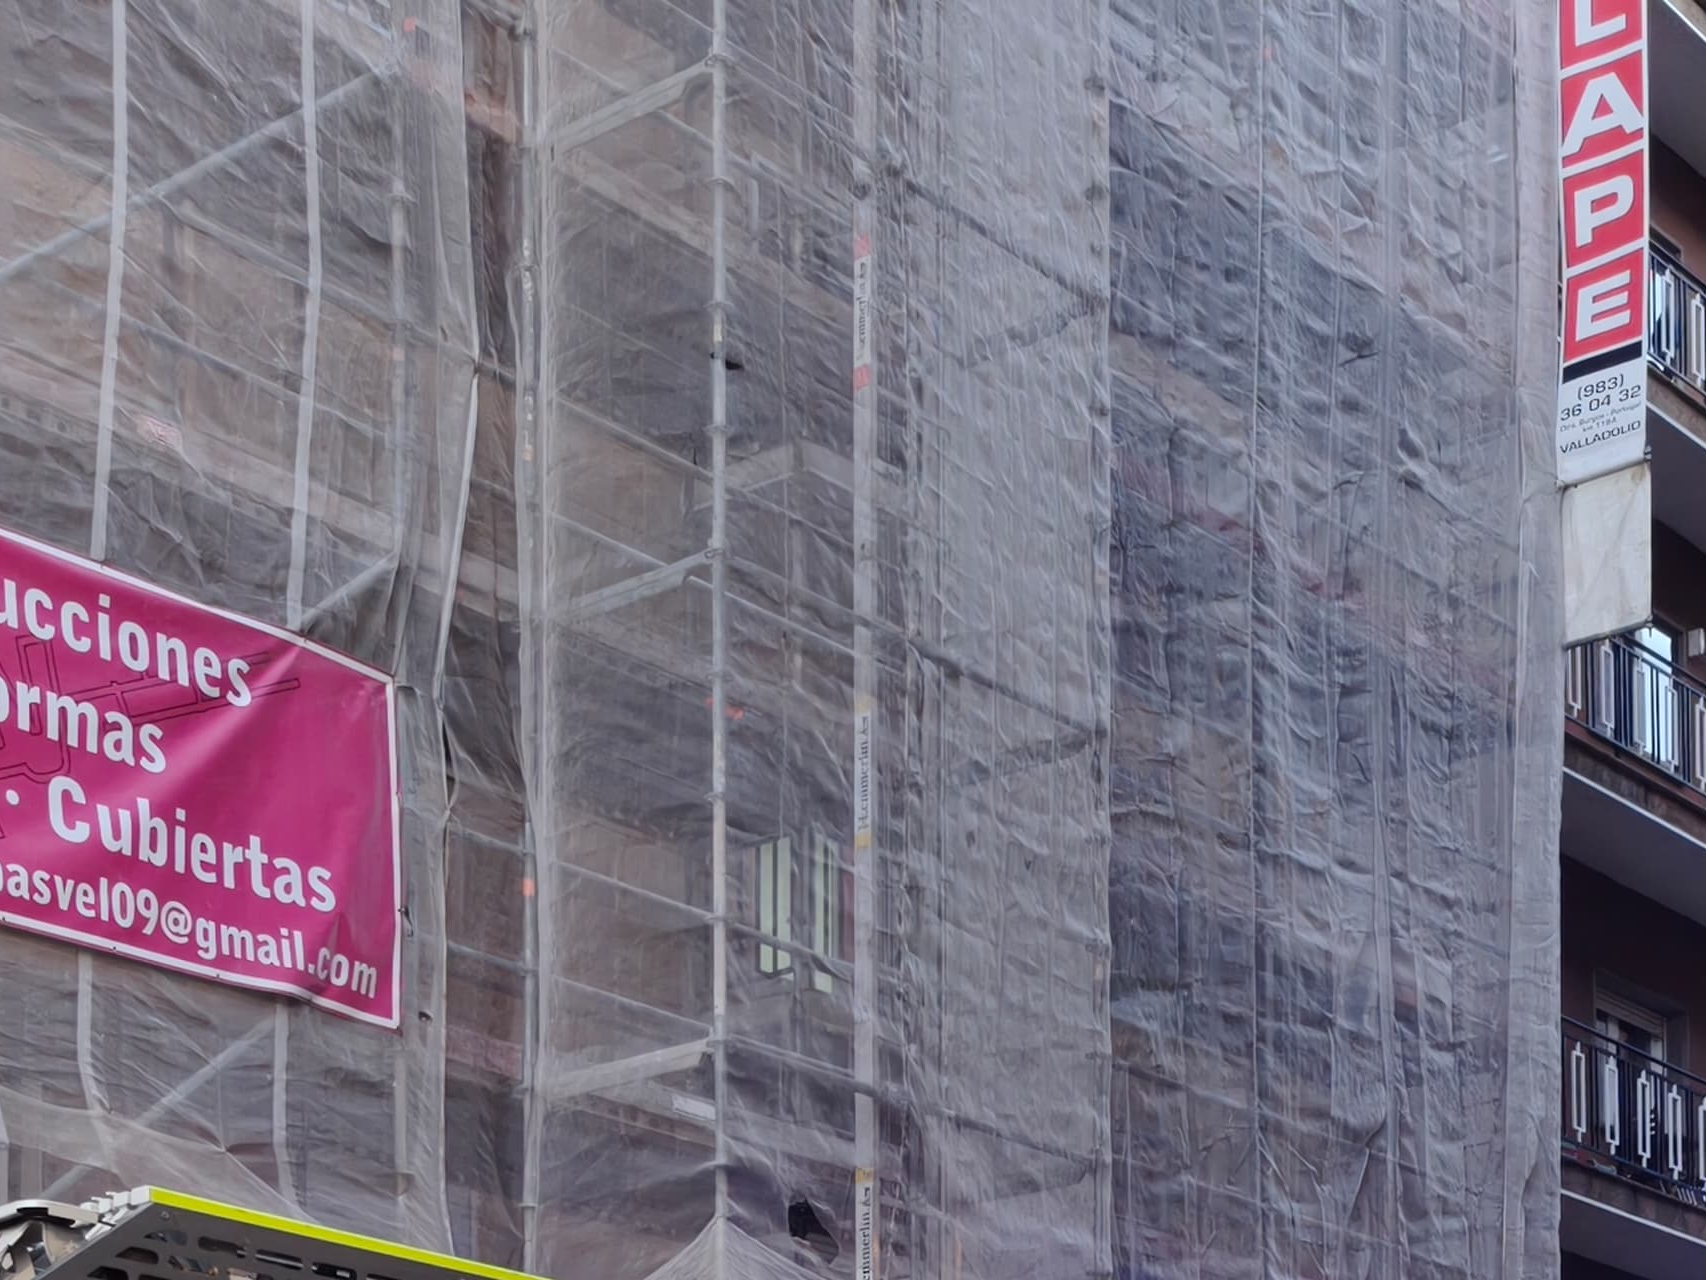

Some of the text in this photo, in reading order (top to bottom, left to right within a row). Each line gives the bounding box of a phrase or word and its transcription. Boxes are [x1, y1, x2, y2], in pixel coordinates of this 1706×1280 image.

[1560, 384, 1642, 421] 36 04 32
[1578, 373, 1624, 400] (983)
[1560, 419, 1642, 453] VALLADOLID
[47, 775, 338, 914] Cubiertas
